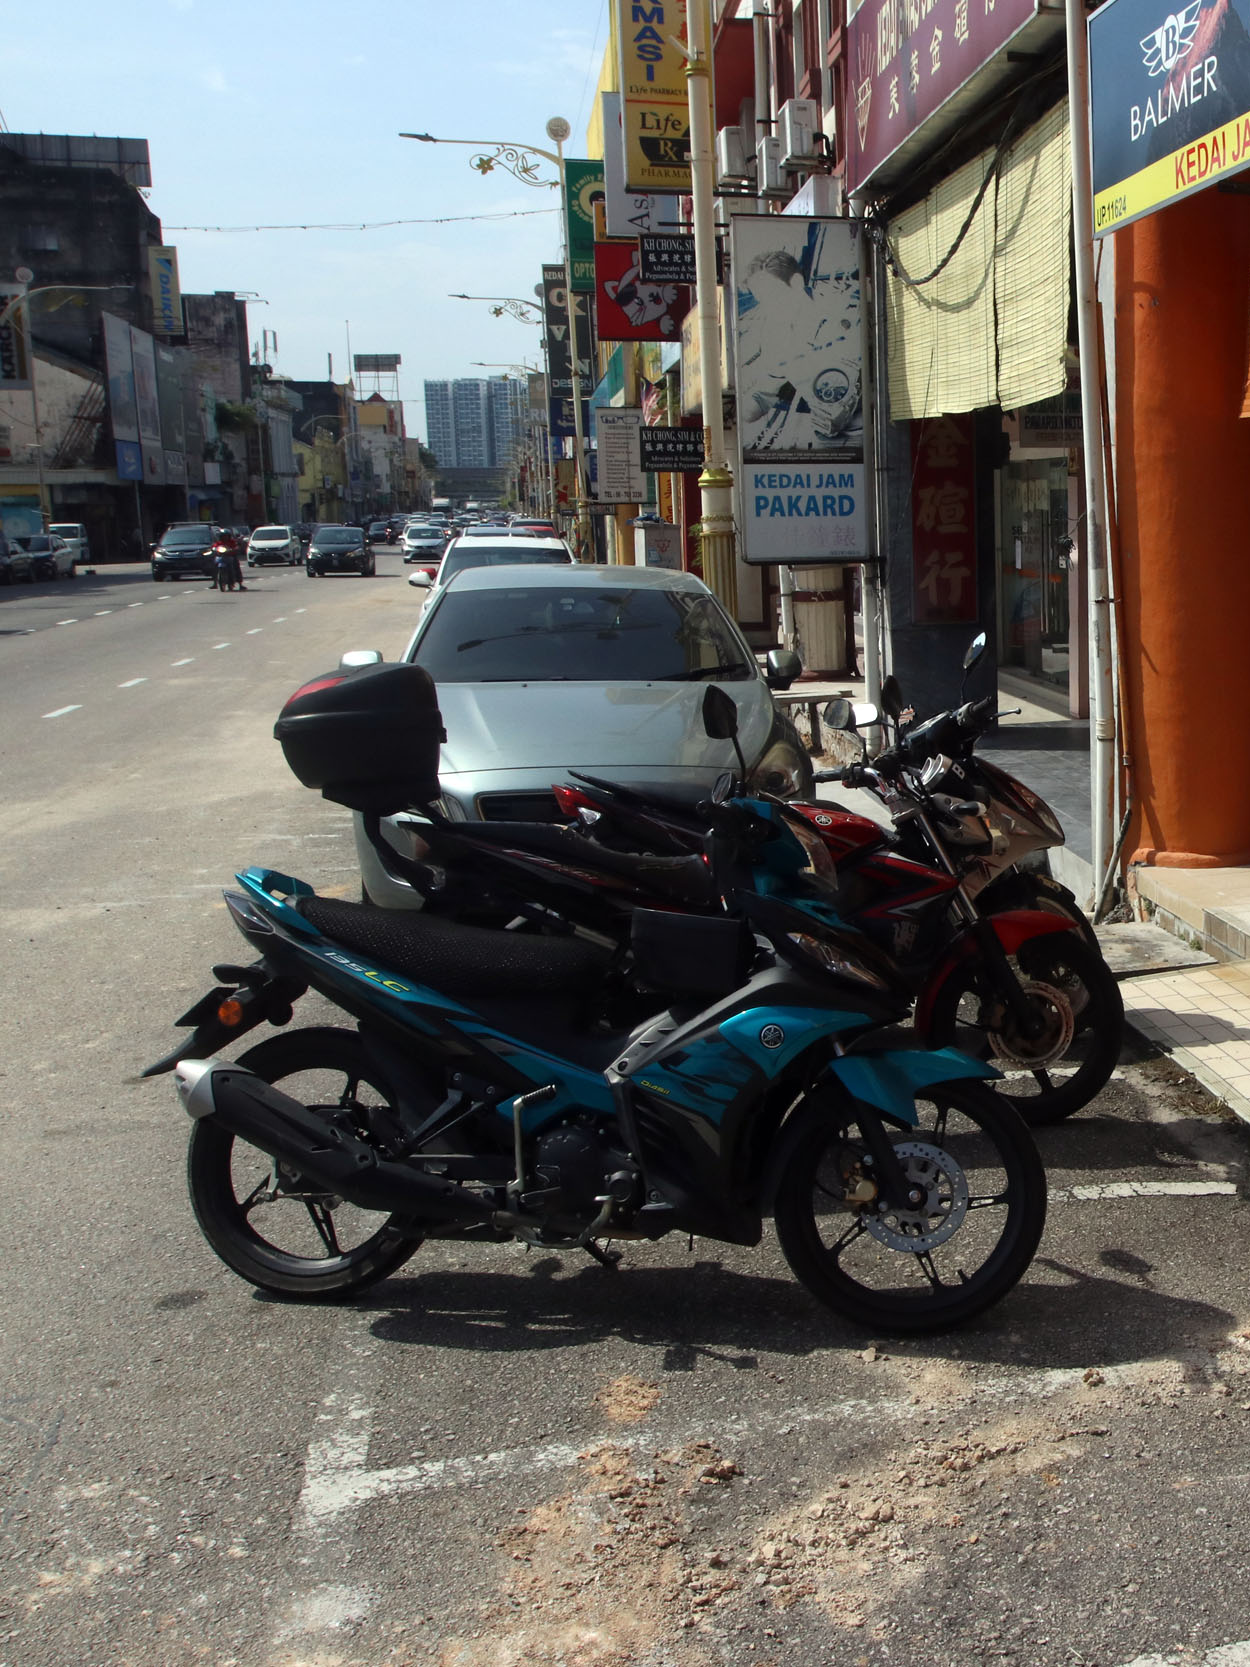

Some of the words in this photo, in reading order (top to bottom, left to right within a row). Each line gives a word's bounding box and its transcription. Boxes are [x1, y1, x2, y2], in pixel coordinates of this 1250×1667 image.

[632, 0, 665, 82] MASI
[1130, 56, 1218, 142] BALMER
[640, 111, 682, 136] Life
[1175, 137, 1227, 190] KEDAI
[1096, 196, 1128, 229] UP.11624
[643, 239, 655, 250] KH
[544, 272, 564, 280] KEDAI
[642, 431, 652, 441] KH
[754, 473, 811, 489] KEDAI
[815, 473, 855, 489] JAM
[755, 494, 856, 517] PAKARD
